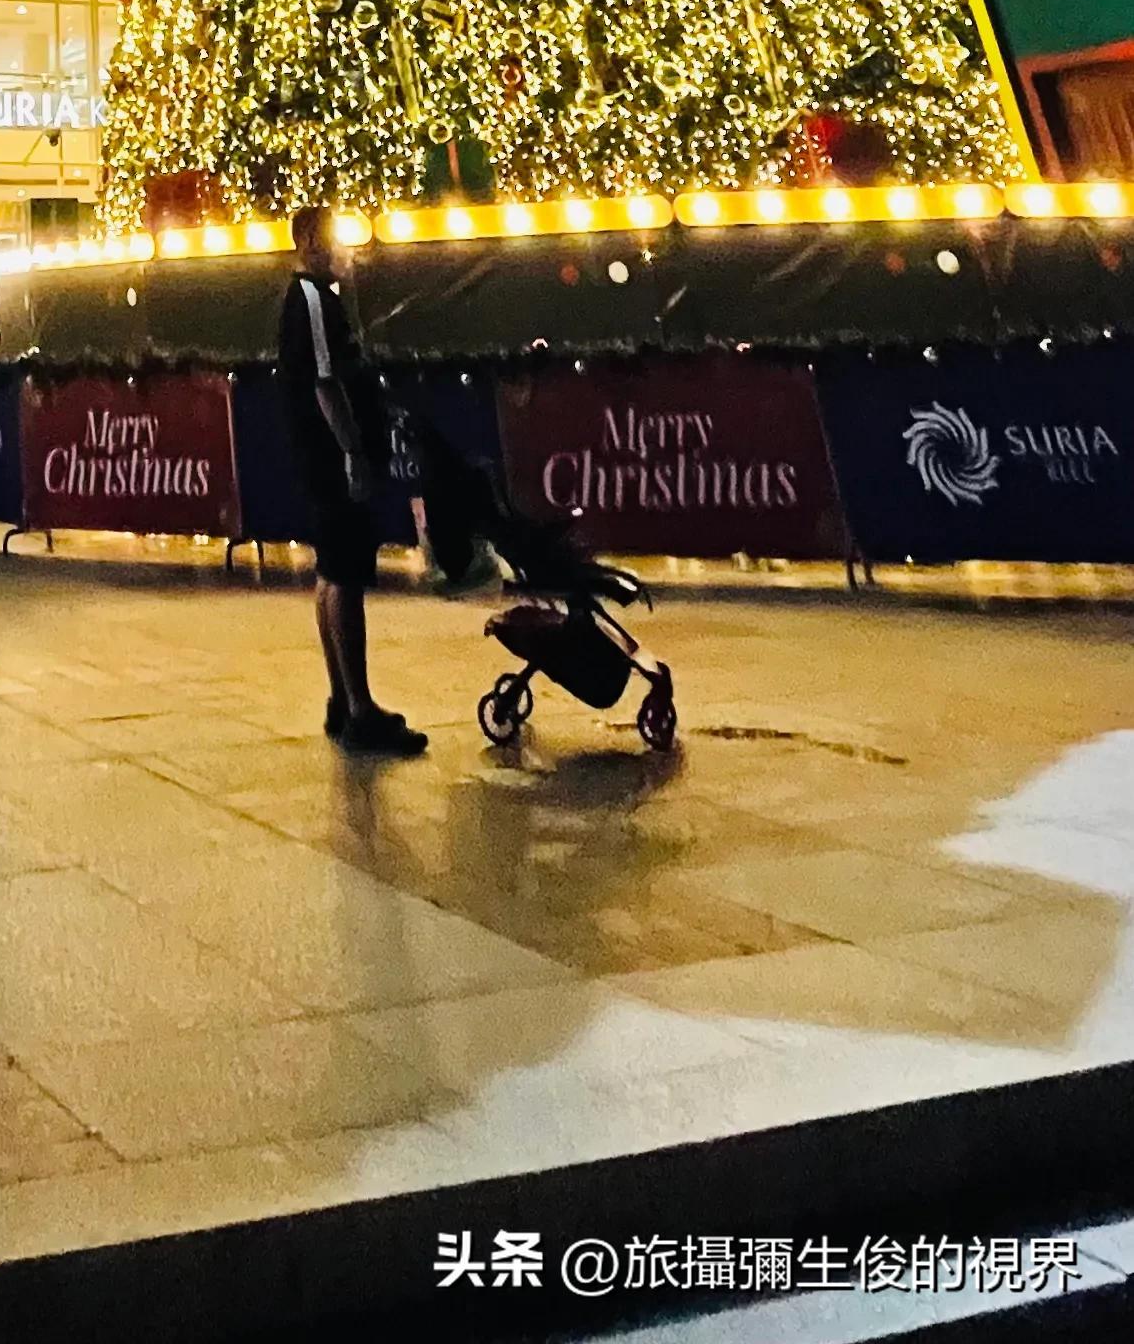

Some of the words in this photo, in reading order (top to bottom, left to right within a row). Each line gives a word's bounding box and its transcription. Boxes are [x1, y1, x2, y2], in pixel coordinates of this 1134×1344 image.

[84, 409, 159, 454] Merry
[602, 408, 714, 457] Merry
[1004, 424, 1120, 457] SURIA
[44, 445, 210, 497] Christmas
[543, 447, 798, 509] Christmas
